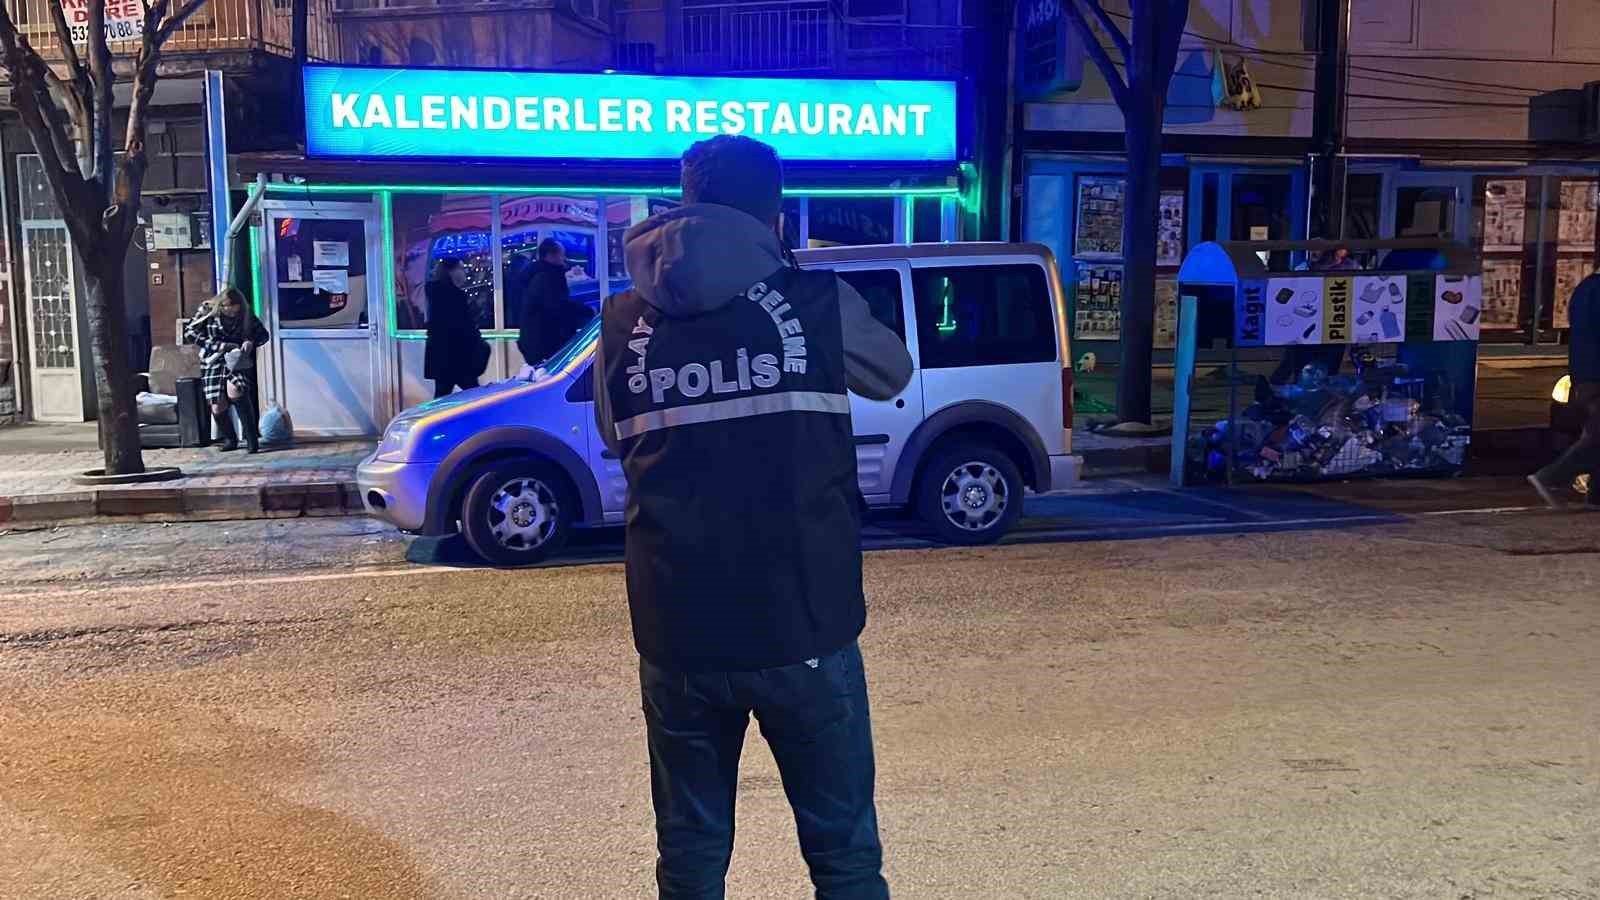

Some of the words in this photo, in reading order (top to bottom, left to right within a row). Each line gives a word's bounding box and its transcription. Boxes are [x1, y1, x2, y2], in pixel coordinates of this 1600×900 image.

[116, 21, 133, 38] 88
[331, 92, 652, 133] KALENDERLER
[665, 100, 932, 136] RESTAURANT
[746, 281, 808, 375] CELEME
[1328, 278, 1349, 341] Plastik
[649, 346, 782, 404] POLİS
